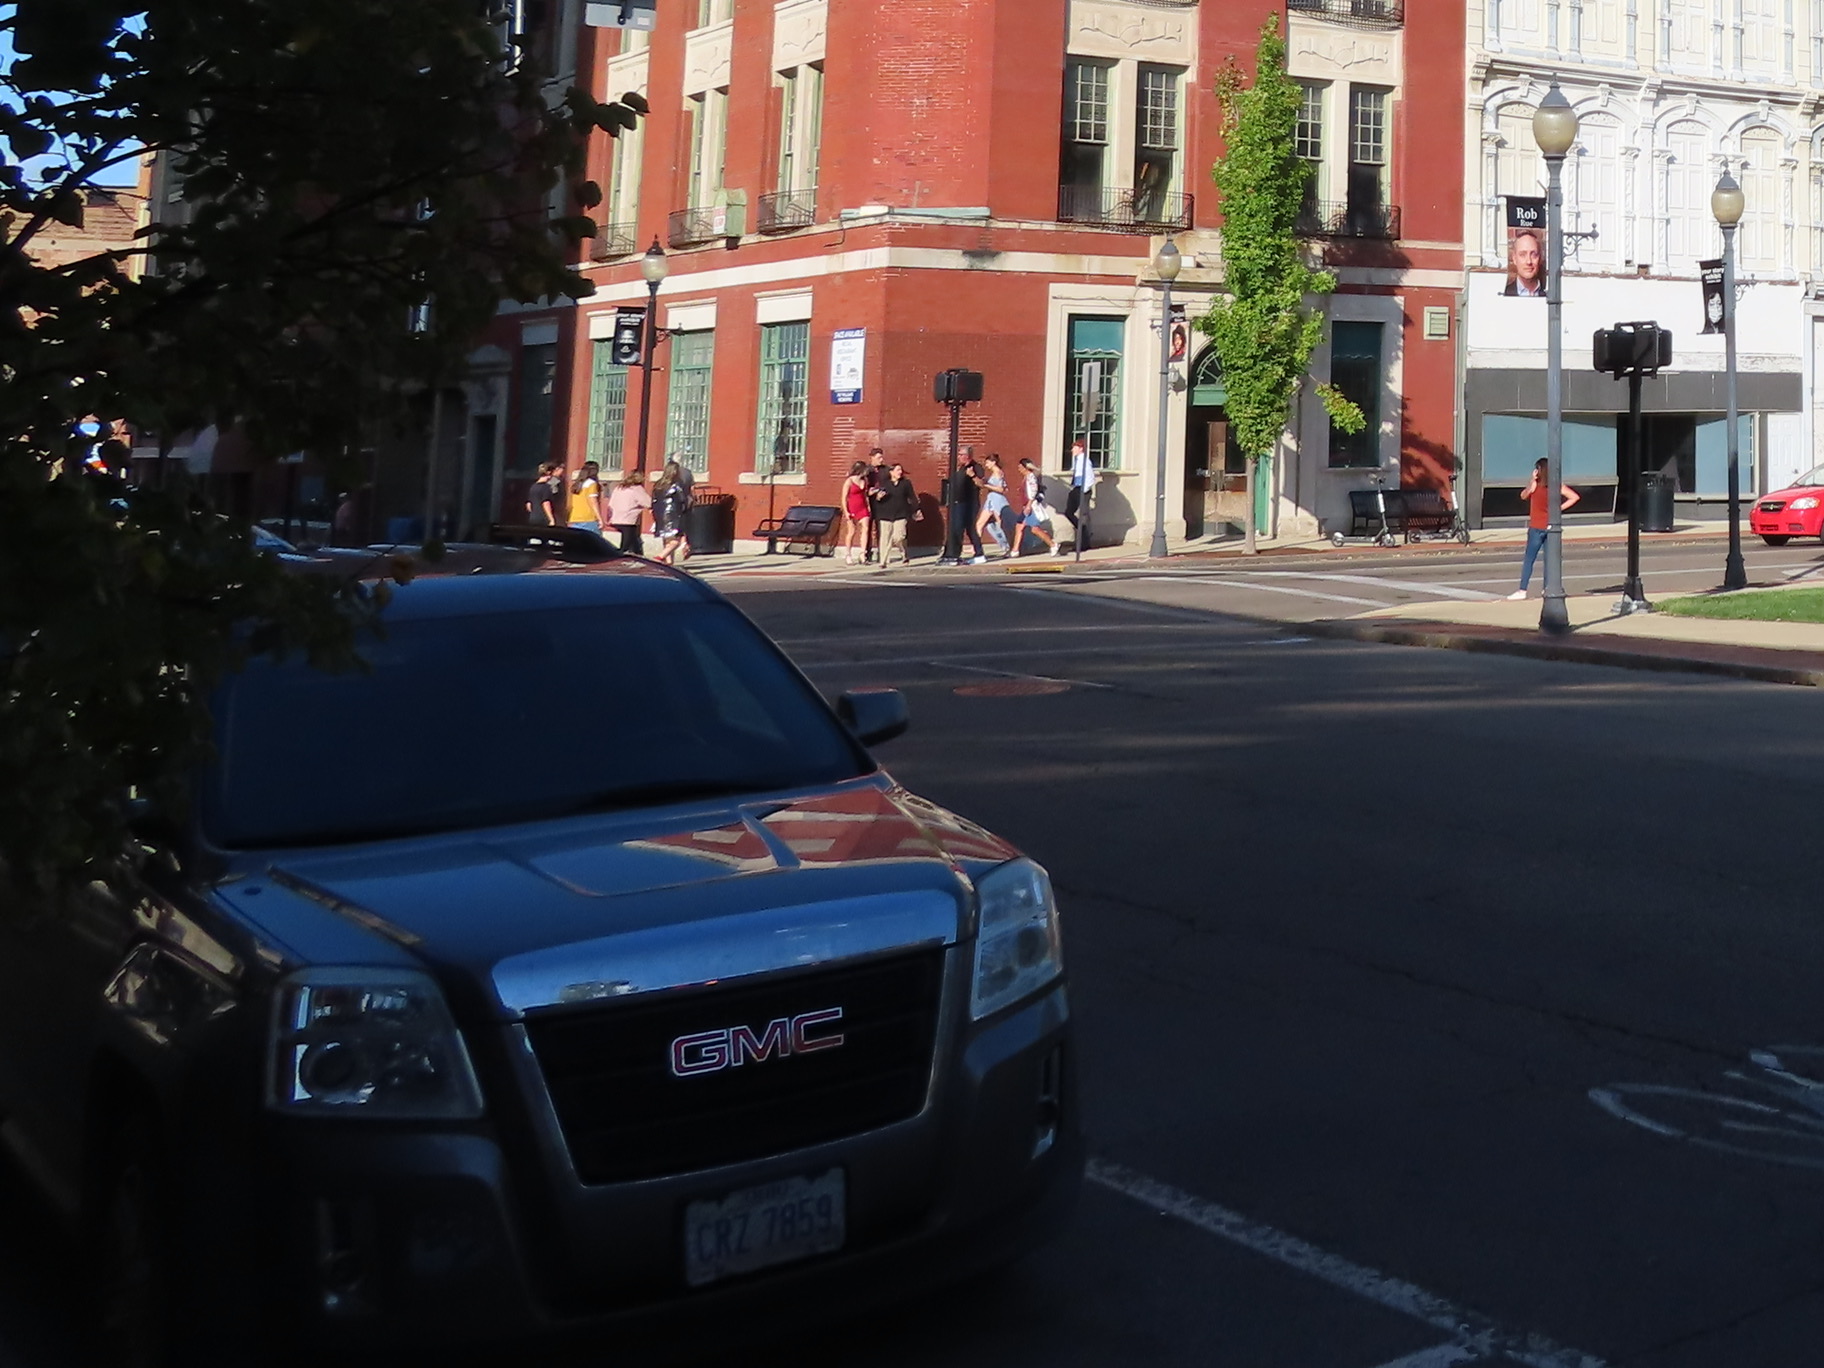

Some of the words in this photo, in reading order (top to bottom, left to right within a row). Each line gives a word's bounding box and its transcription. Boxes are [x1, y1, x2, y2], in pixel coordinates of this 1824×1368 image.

[1516, 207, 1538, 220] Rob
[1520, 219, 1534, 227] Rue
[671, 1006, 844, 1077] GMC
[697, 1212, 751, 1263] CRZ
[762, 1193, 833, 1247] 7859
